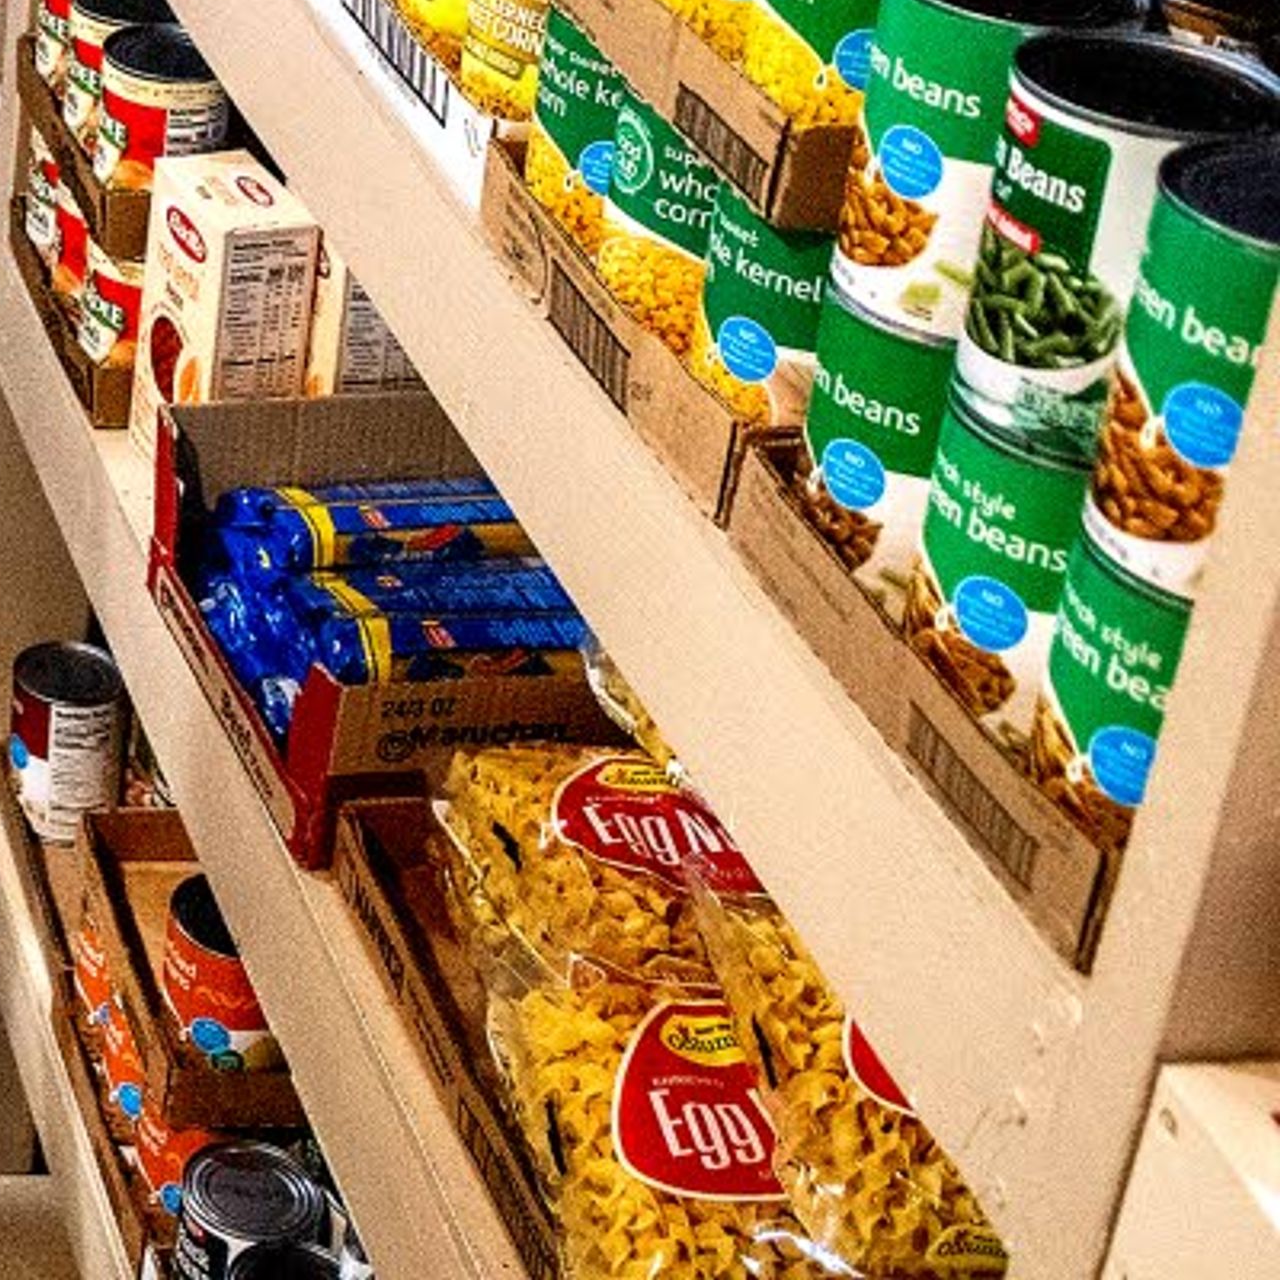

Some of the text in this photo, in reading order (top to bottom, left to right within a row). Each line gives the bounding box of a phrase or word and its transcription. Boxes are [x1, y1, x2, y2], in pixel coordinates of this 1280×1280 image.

[893, 57, 983, 119] beans
[1006, 150, 1087, 214] Beans
[735, 246, 823, 303] kernel
[833, 378, 922, 437] beans
[962, 483, 1017, 522] style
[966, 513, 1069, 573] beans
[1101, 622, 1163, 672] style
[583, 802, 683, 866] Egg
[647, 1088, 767, 1171] Egg
